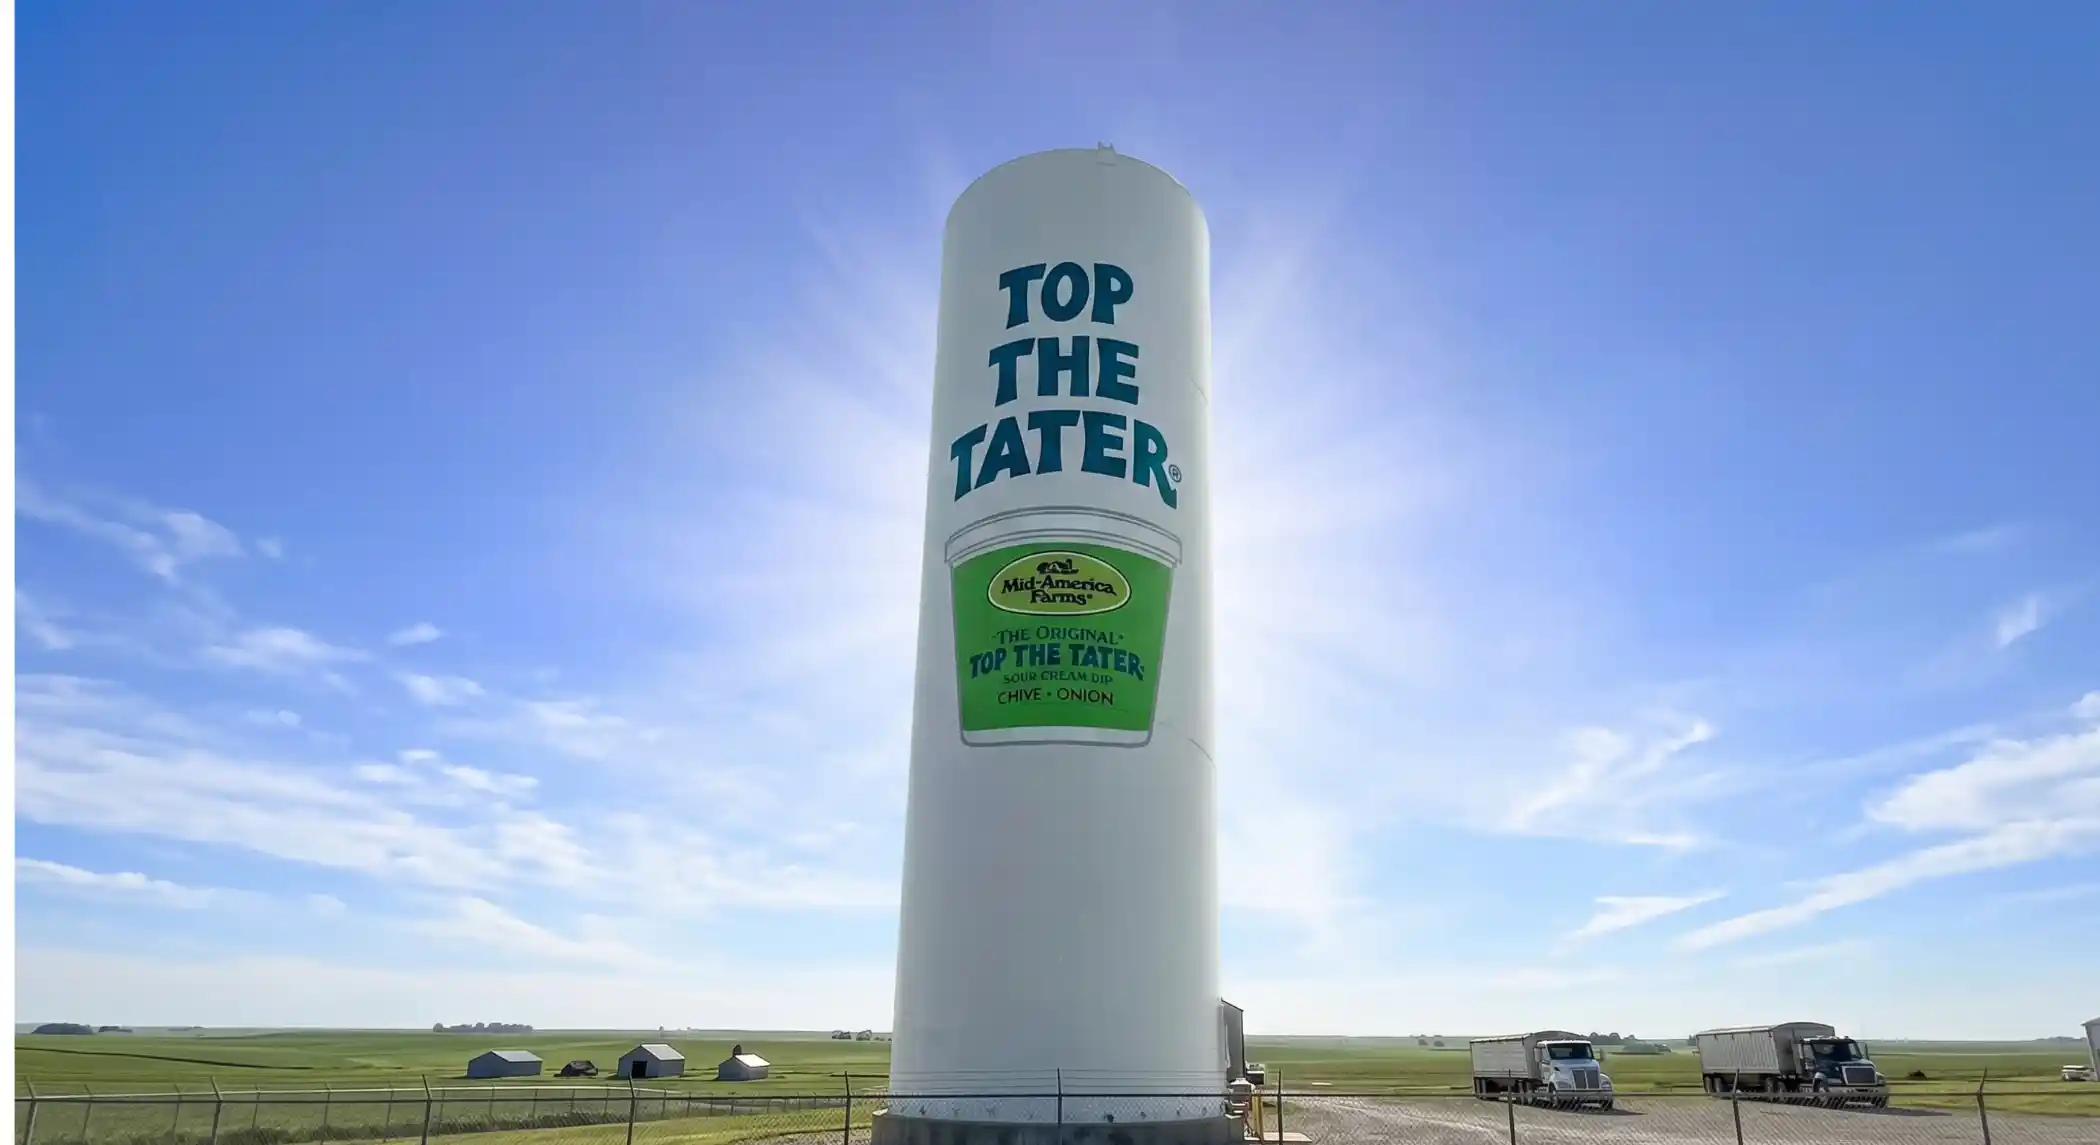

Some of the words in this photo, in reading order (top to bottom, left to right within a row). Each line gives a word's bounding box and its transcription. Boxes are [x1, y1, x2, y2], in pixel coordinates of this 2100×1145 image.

[999, 261, 1134, 330] TOP
[988, 335, 1140, 408] THE
[1001, 575, 1117, 597] Mid-America
[1036, 626, 1118, 645] ORIGINAL
[969, 648, 1007, 679] TOP
[1013, 643, 1061, 667] THE
[1003, 672, 1038, 685] SOUR
[1040, 671, 1087, 683] CREAM
[1091, 672, 1114, 685] DIP
[997, 688, 1042, 705] CHIVE
[1056, 687, 1114, 706] ONION
